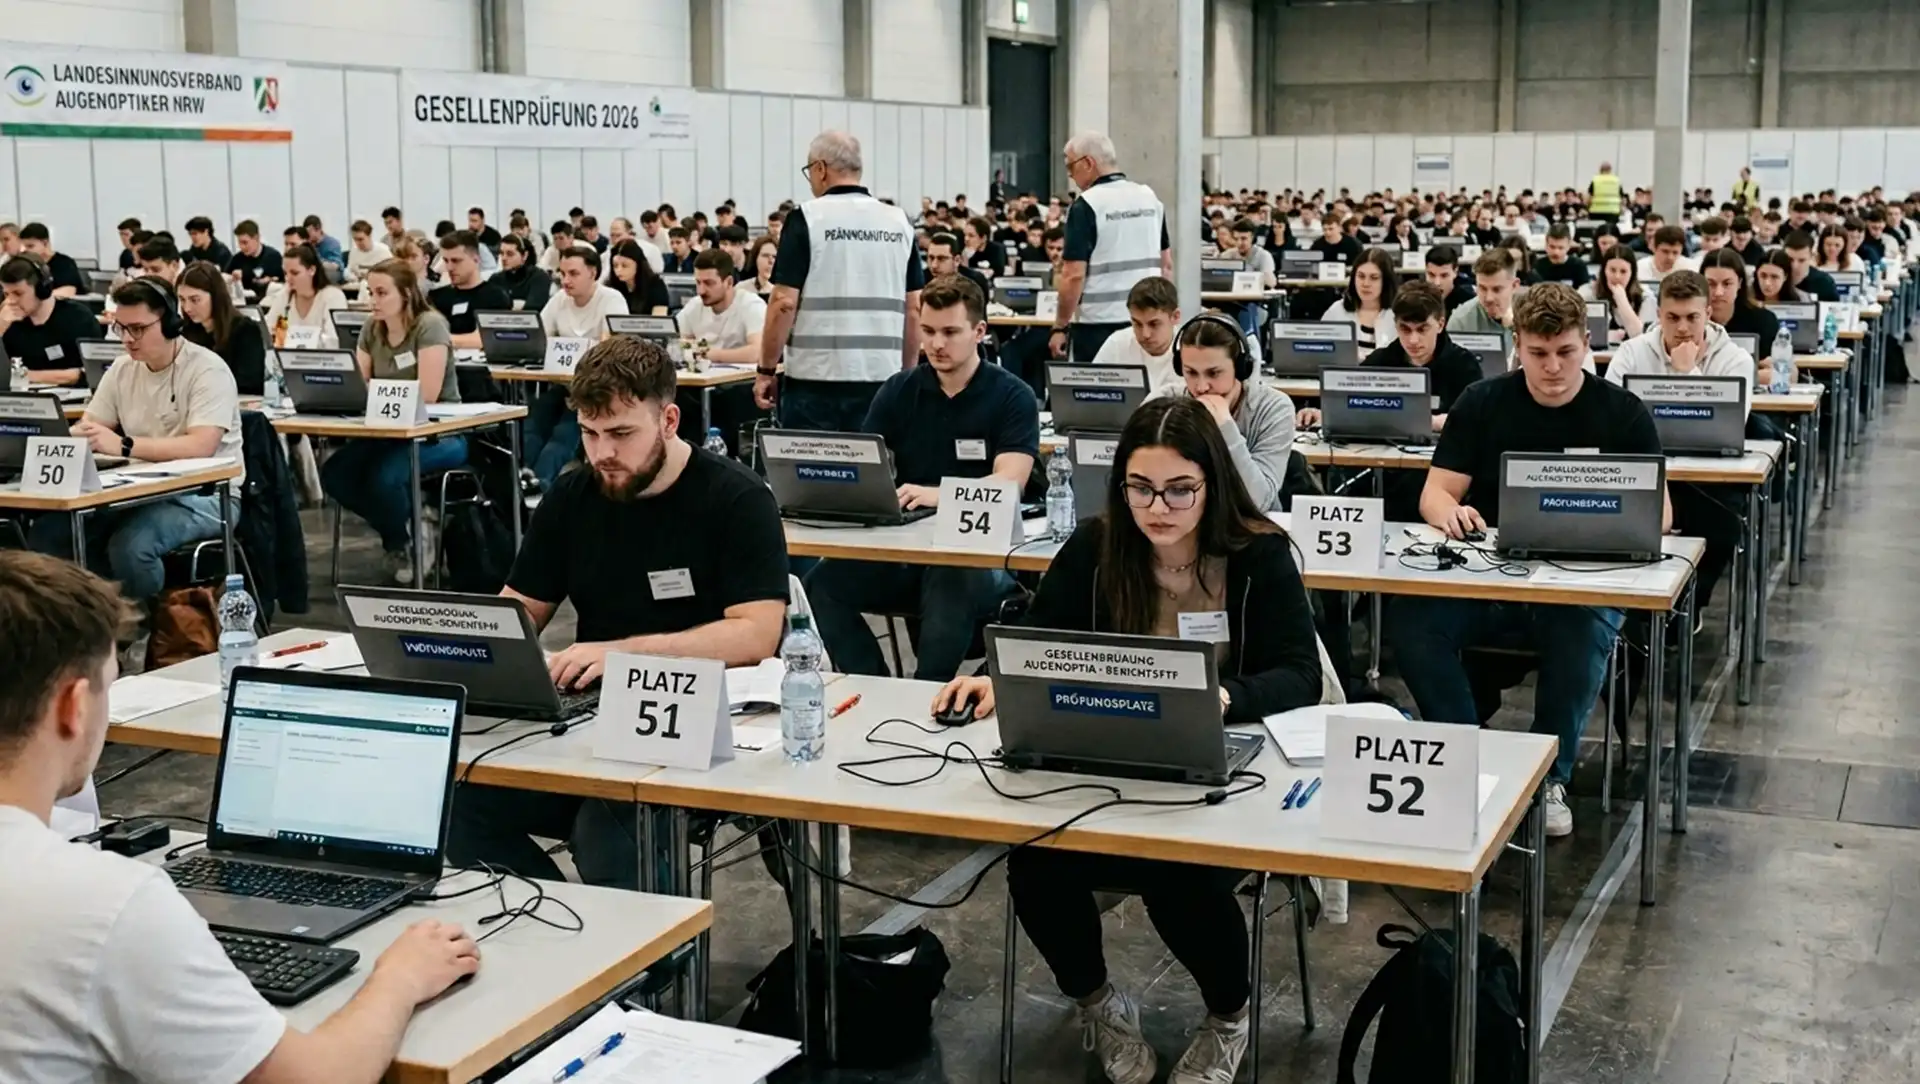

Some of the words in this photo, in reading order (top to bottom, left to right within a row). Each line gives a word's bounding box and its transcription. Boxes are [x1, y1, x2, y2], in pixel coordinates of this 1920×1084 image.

[56, 90, 169, 112] AUGENOPTIKER
[173, 95, 205, 113] NRW
[415, 94, 597, 128] GESELLENPRÜFUNG
[602, 104, 639, 129] 2026
[38, 464, 65, 485] 50
[954, 487, 1003, 503] PLATZ
[958, 510, 991, 535] 54
[1310, 505, 1364, 523] PLATZ
[1316, 530, 1352, 556] 53
[627, 668, 697, 695] PLATZ
[635, 700, 682, 739] 51
[1355, 735, 1446, 766] PLATZ
[1367, 772, 1425, 816] 52
